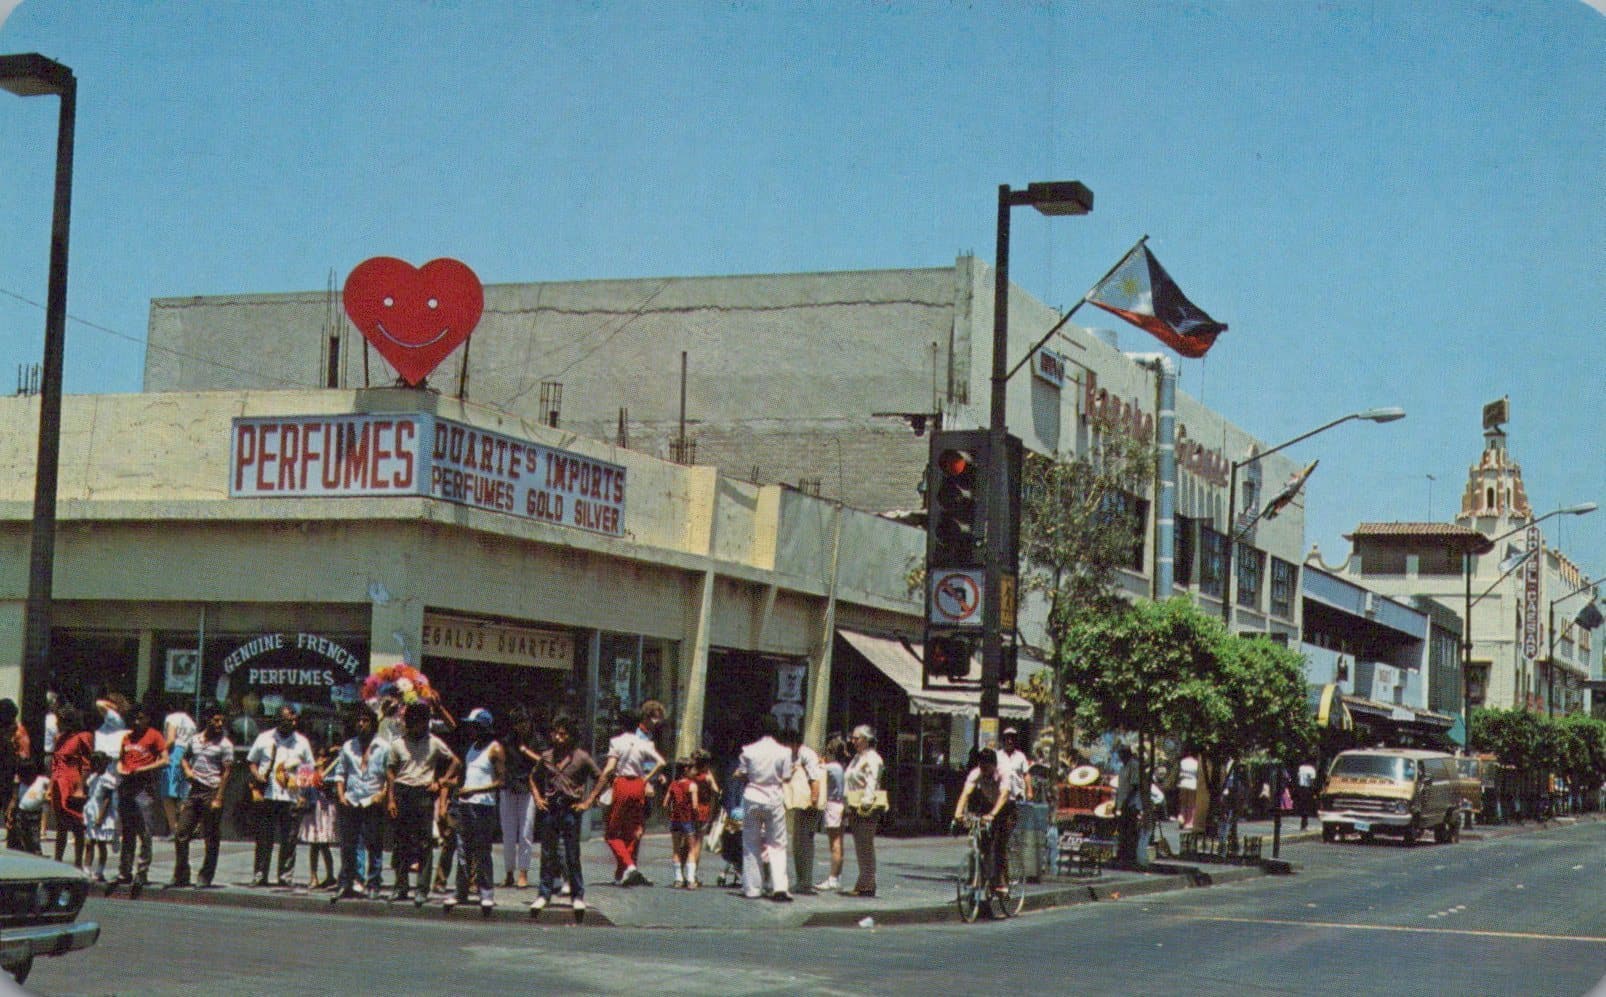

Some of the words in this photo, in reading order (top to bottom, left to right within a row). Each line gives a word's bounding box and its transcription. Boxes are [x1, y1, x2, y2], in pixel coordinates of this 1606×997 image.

[235, 421, 415, 491] PERFUMES
[432, 422, 537, 479] DUARTE'S
[545, 452, 625, 504] IMPORTS
[432, 465, 515, 512] PERFUMES
[527, 488, 563, 522] GOLD
[574, 499, 620, 534] SILVER
[223, 633, 283, 674] GENUINE
[297, 633, 360, 675] FRENCH
[249, 669, 335, 686] PERFUMES
